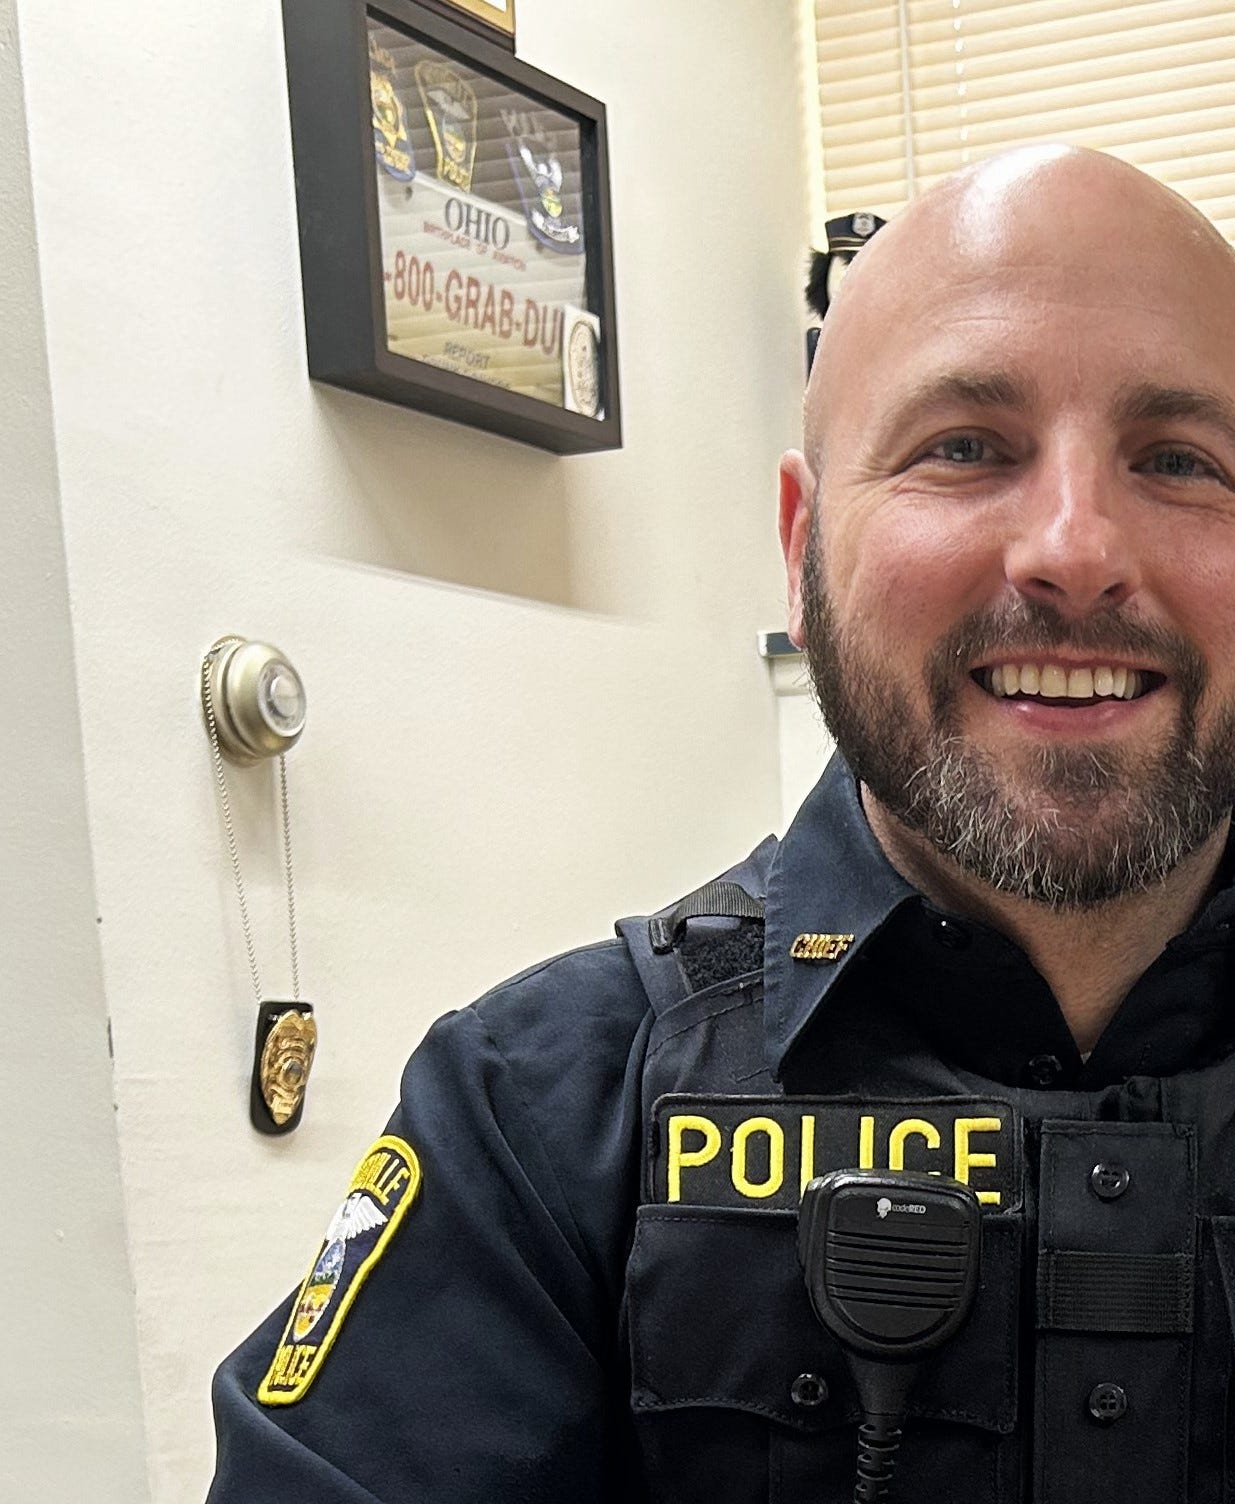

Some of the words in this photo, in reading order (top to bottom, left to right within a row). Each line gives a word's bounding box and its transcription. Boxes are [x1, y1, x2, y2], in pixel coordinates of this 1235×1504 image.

[445, 197, 510, 250] OHIO
[790, 933, 855, 960] CHIEF
[667, 1115, 1002, 1204] POLICE
